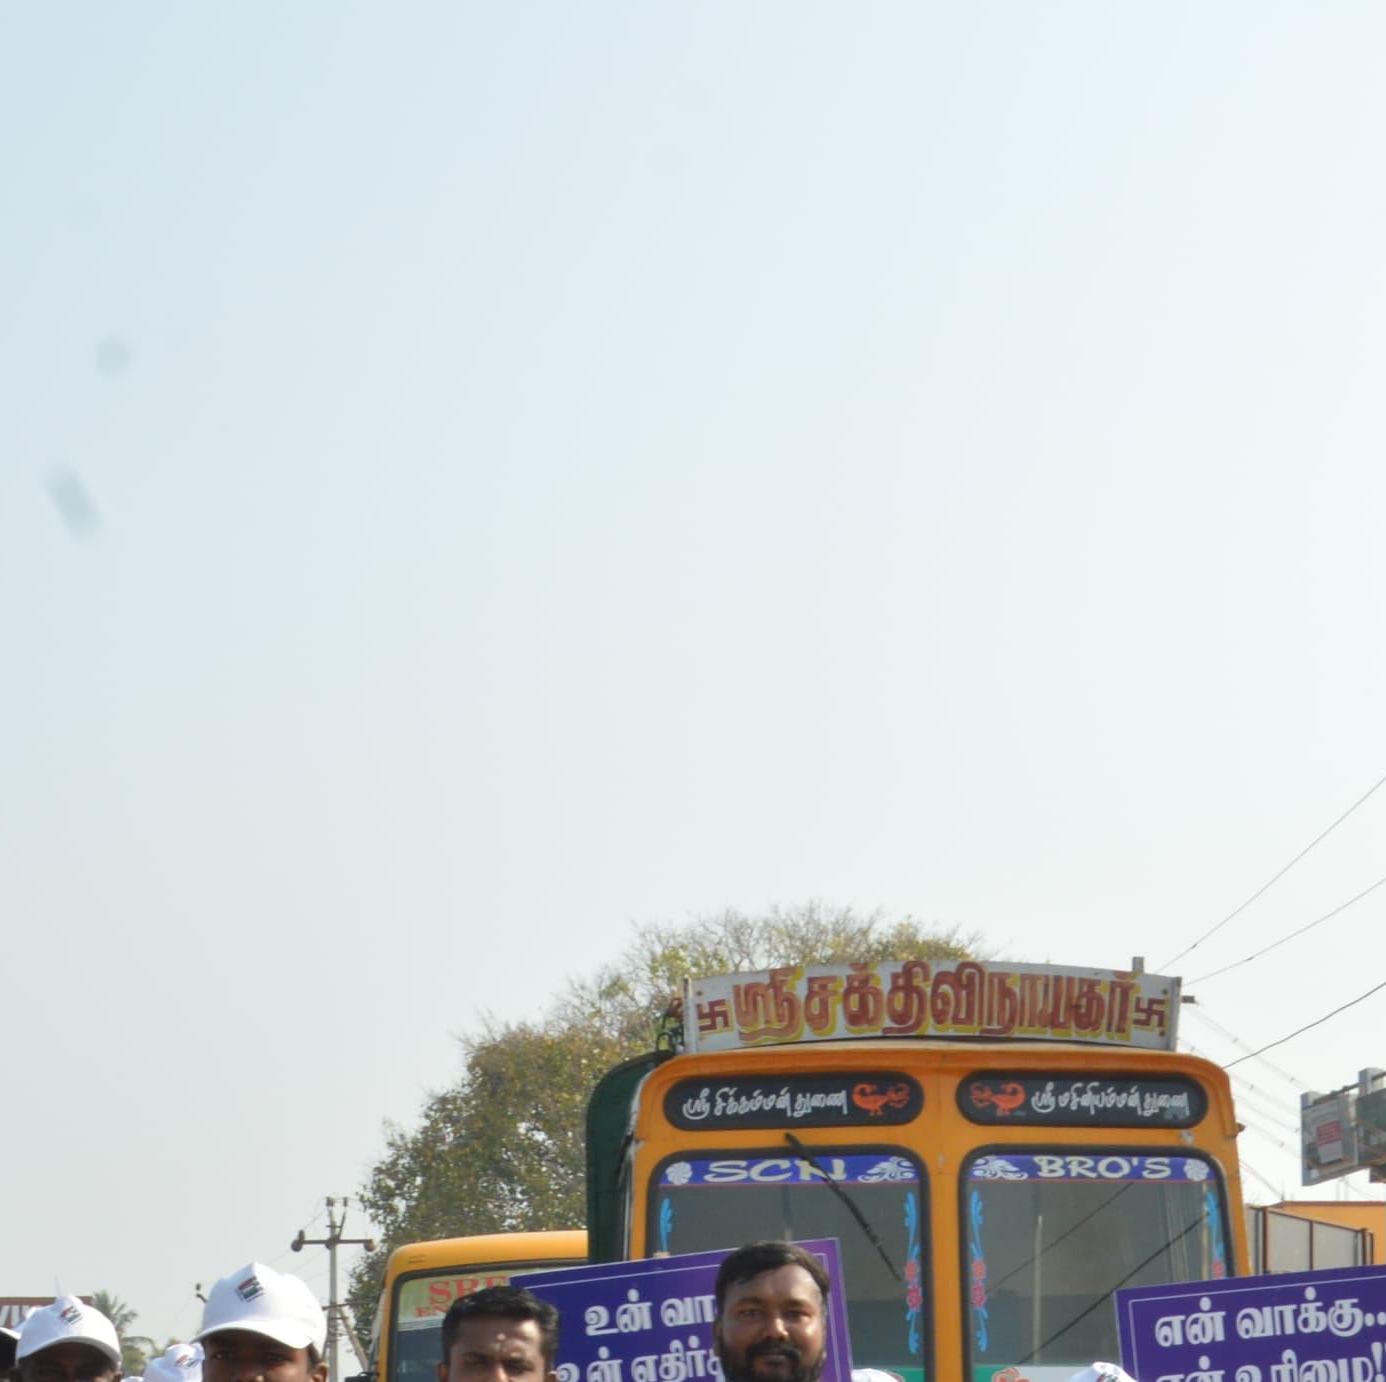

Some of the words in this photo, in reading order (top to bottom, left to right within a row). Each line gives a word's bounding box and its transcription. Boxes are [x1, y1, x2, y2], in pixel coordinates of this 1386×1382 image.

[682, 1087, 711, 1120] ஸ்ரீ
[794, 1089, 848, 1118] துணை
[1031, 1082, 1055, 1113] ஸ்ரீ
[1143, 1091, 1190, 1117] துணை
[703, 1159, 846, 1183] SCN
[1033, 1156, 1174, 1179] BRO'S
[584, 1288, 653, 1337] உன்
[660, 1294, 718, 1328] வா
[1154, 1296, 1227, 1348] என்
